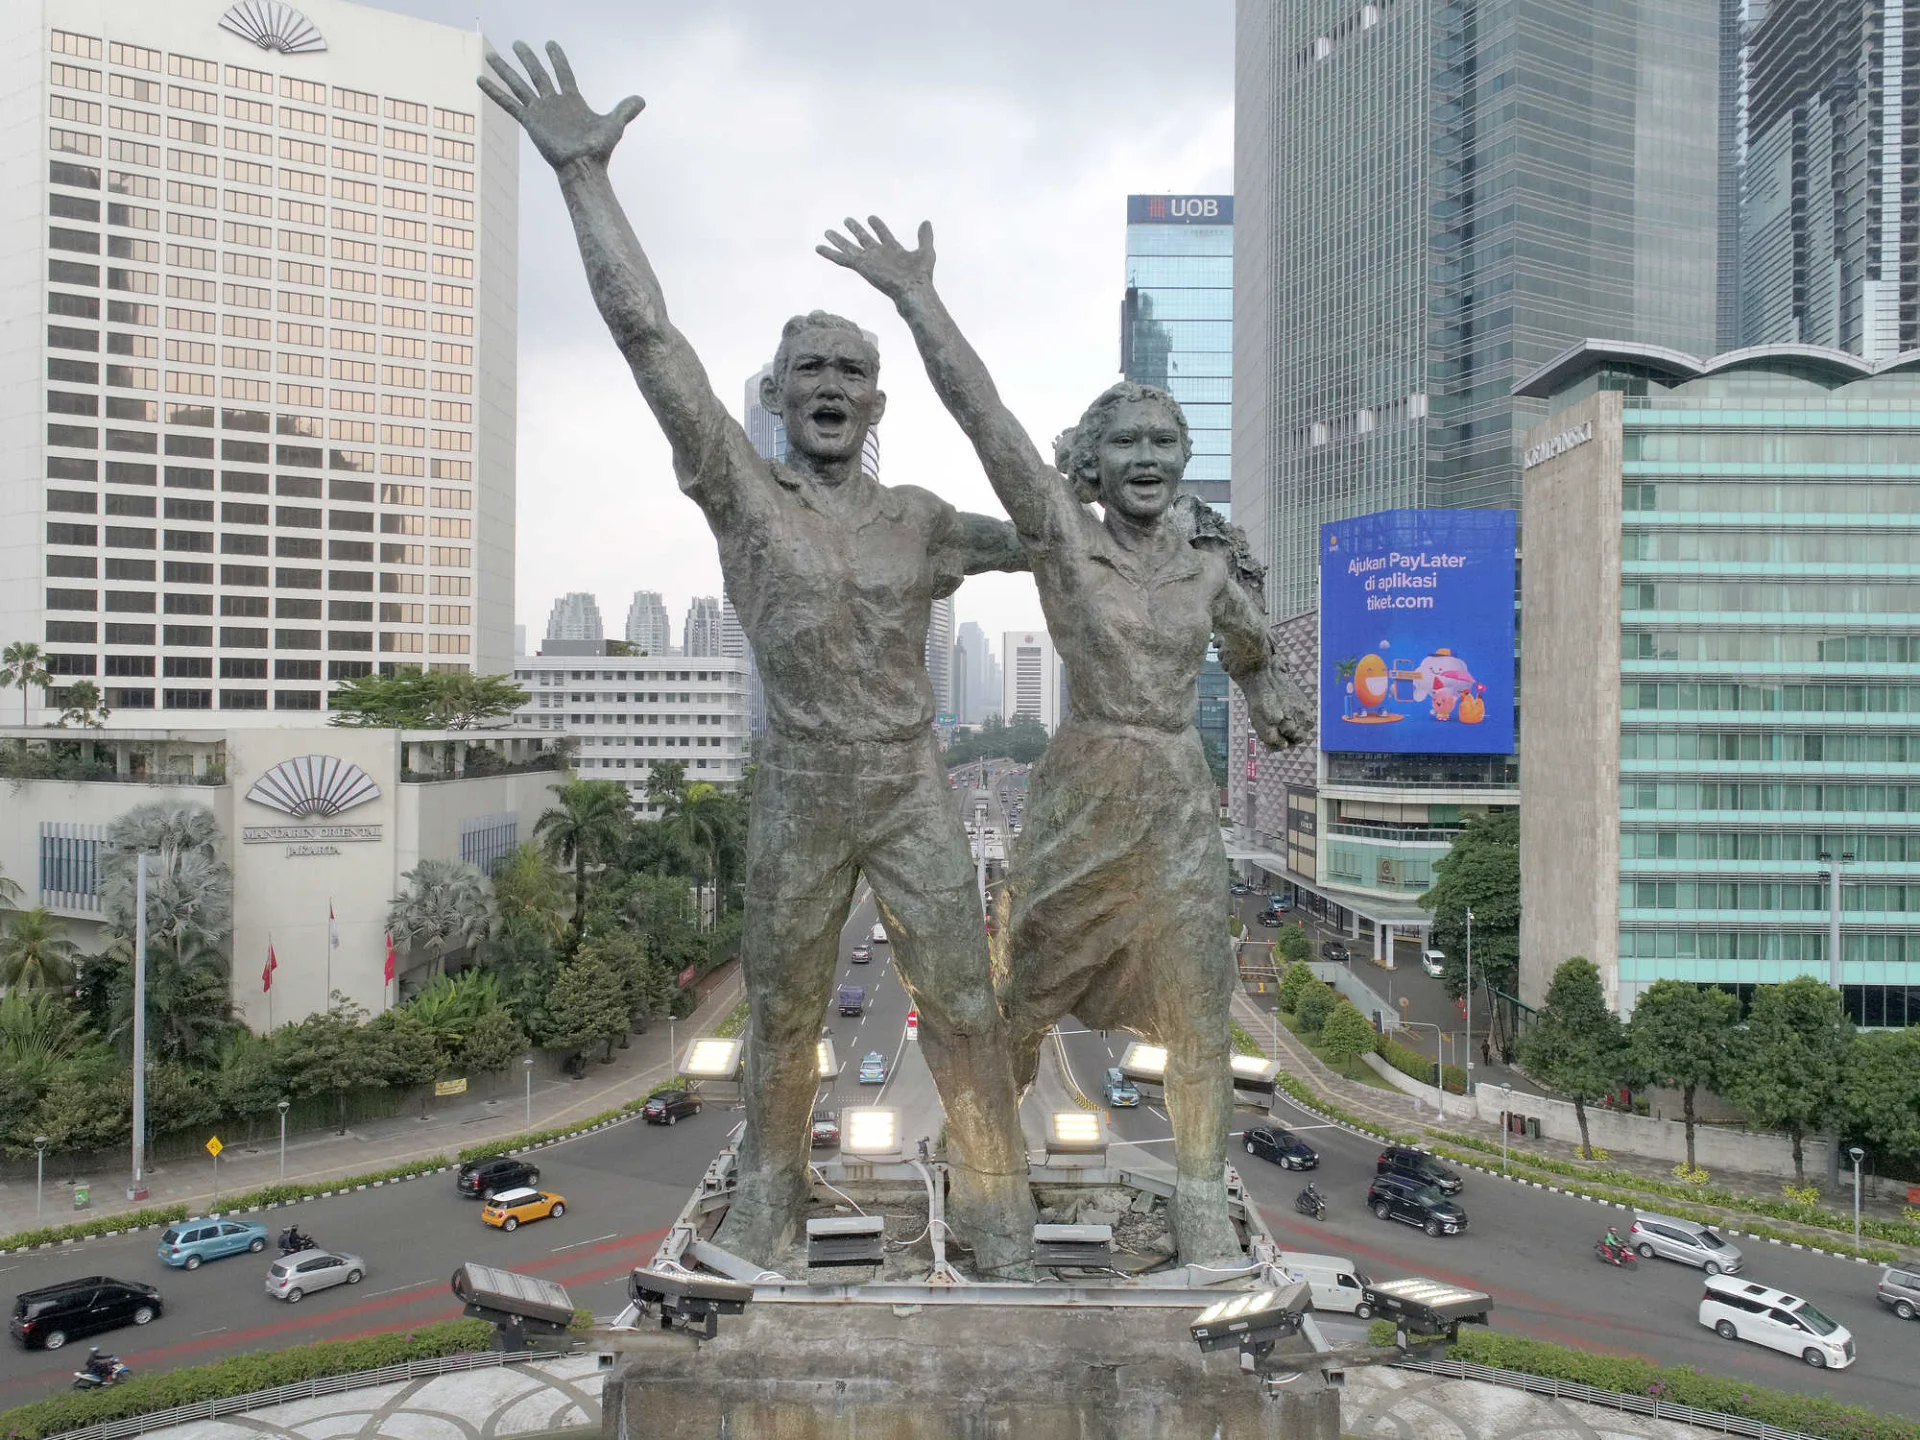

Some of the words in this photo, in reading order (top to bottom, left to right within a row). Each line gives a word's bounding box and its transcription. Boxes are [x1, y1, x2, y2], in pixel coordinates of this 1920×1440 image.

[1171, 199, 1219, 217] UOB
[1348, 555, 1386, 577] Ajukan
[1389, 552, 1466, 571] PayLater
[1364, 576, 1375, 591] di
[1378, 572, 1437, 592] aplikasi
[1366, 595, 1434, 611] tiket.com
[243, 828, 316, 840] MANDARIN
[319, 826, 382, 838] ORIENTAL
[284, 844, 341, 859] JAKARTA
